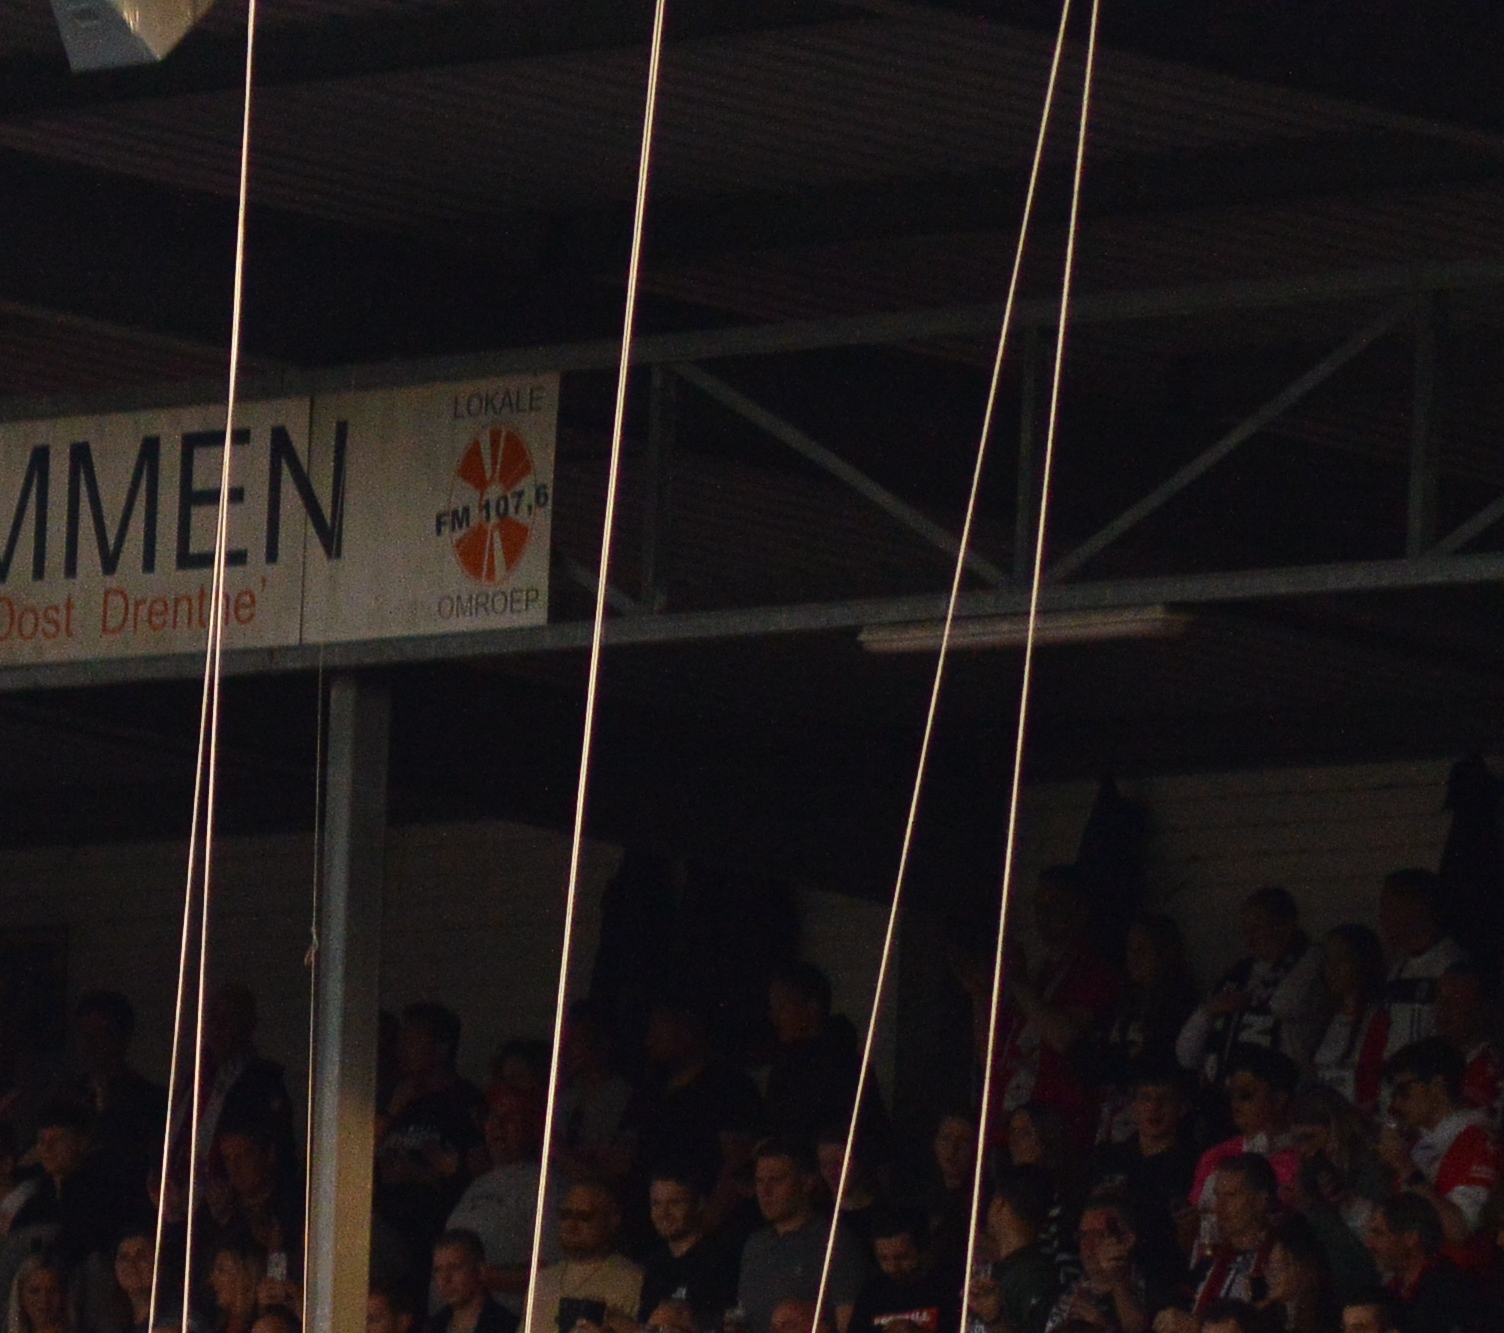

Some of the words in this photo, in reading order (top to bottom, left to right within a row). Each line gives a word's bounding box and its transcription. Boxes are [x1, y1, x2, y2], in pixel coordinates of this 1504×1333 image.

[453, 386, 543, 420] LOKALE
[434, 509, 470, 537] FM
[481, 484, 550, 521] 107,6
[438, 587, 541, 621] OMROEP
